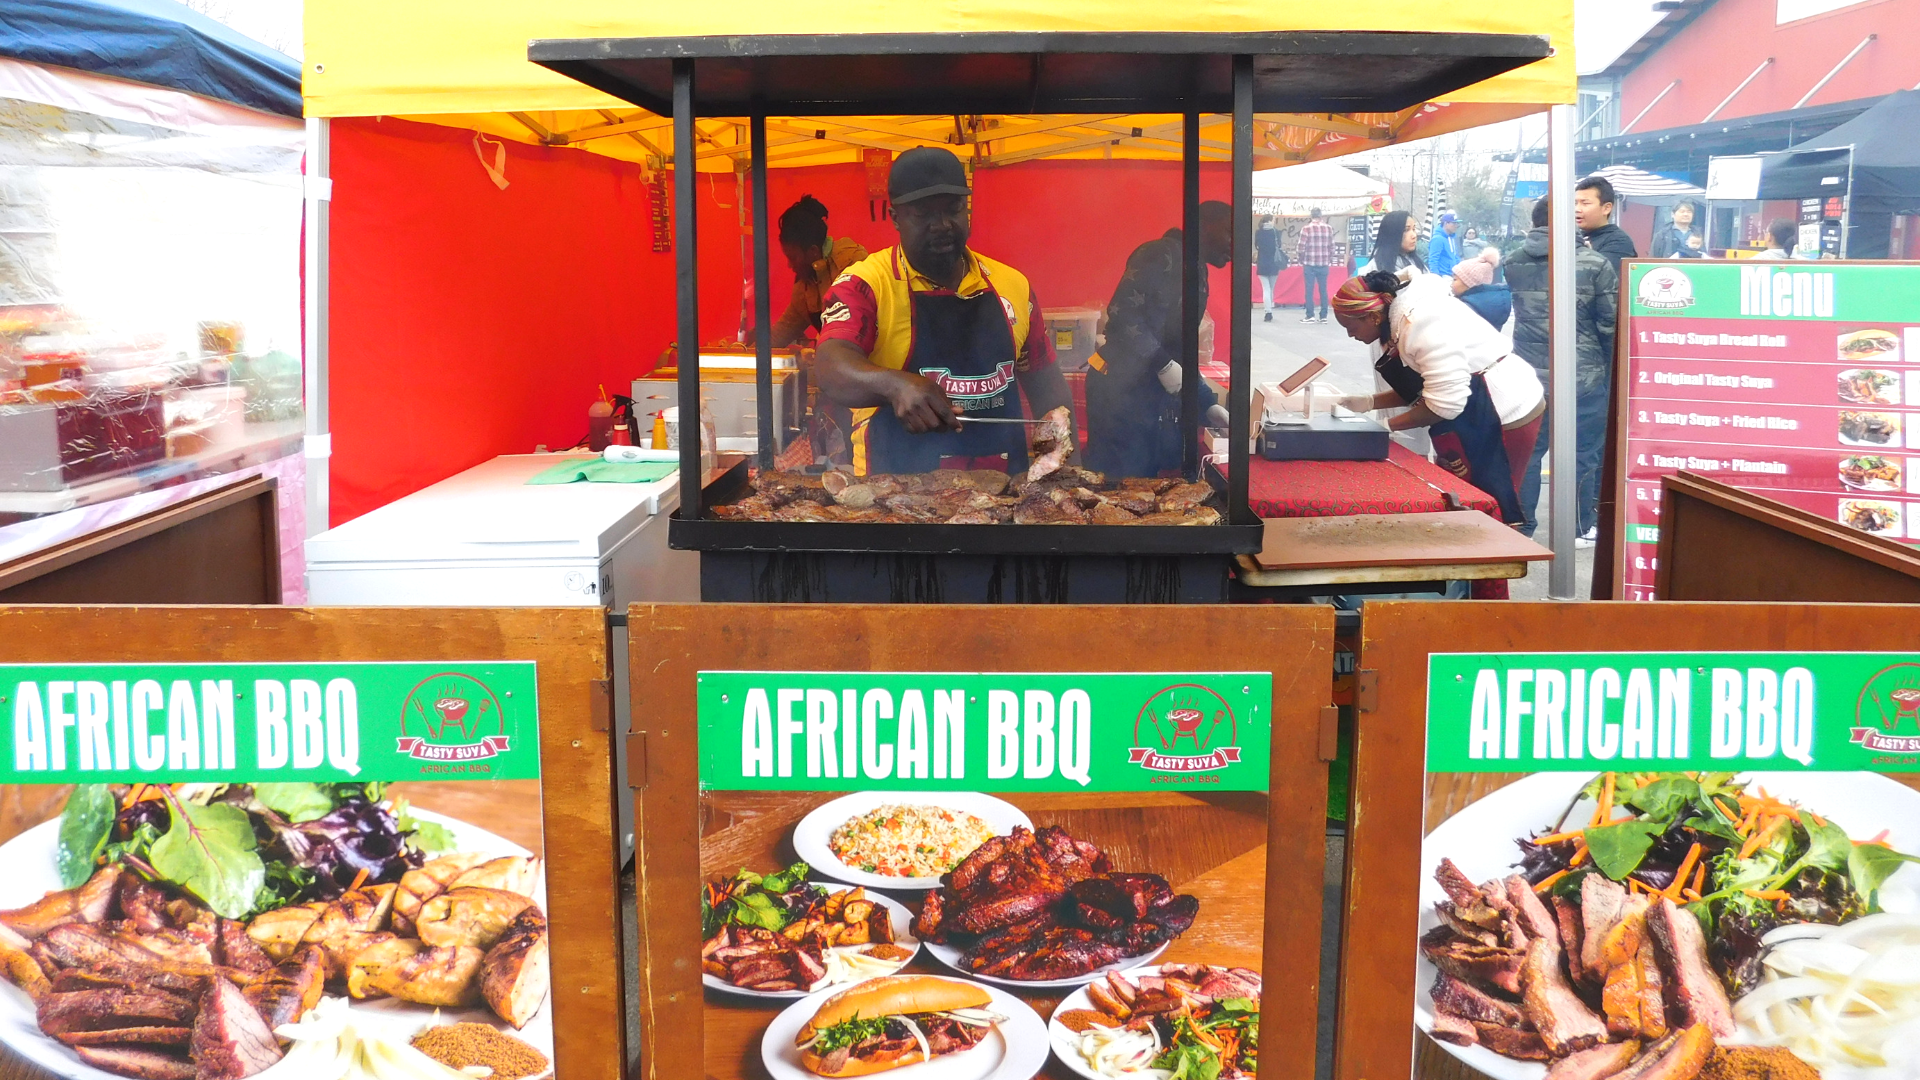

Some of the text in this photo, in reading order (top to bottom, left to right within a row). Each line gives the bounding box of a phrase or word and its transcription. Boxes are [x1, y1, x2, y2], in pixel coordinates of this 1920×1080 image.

[1740, 266, 1834, 317] Menu
[1639, 331, 1787, 348] 1. Tasty Suya Bread Roll
[946, 375, 1002, 393] TASTY SUYA
[1638, 371, 1773, 389] 2. Original Tasty Suya
[1638, 410, 1650, 423] 3.
[1653, 411, 1688, 426] Tasty
[1688, 412, 1721, 427] Suya
[1732, 415, 1766, 429] Fried
[1767, 417, 1798, 430] Rice
[1637, 453, 1648, 466] 4.
[1653, 454, 1687, 470] Tasty
[1687, 456, 1720, 471] Suya
[1731, 459, 1787, 474] Plantain
[1636, 487, 1648, 500] 5.
[1635, 556, 1647, 570] 6.
[1468, 667, 1815, 767] AFRICAN BBQ
[14, 677, 362, 777] AFRICAN BBQ
[741, 687, 1092, 787] AFRICAN BBQ
[1872, 736, 1905, 749] TASTY
[420, 745, 489, 759] TASTY SUYA
[1871, 755, 1917, 765] AFRICAN
[420, 764, 491, 774] AFRICAN BBQ
[1151, 756, 1220, 769] TASTY SUYA
[1150, 775, 1220, 784] AFRICAN BBQ
